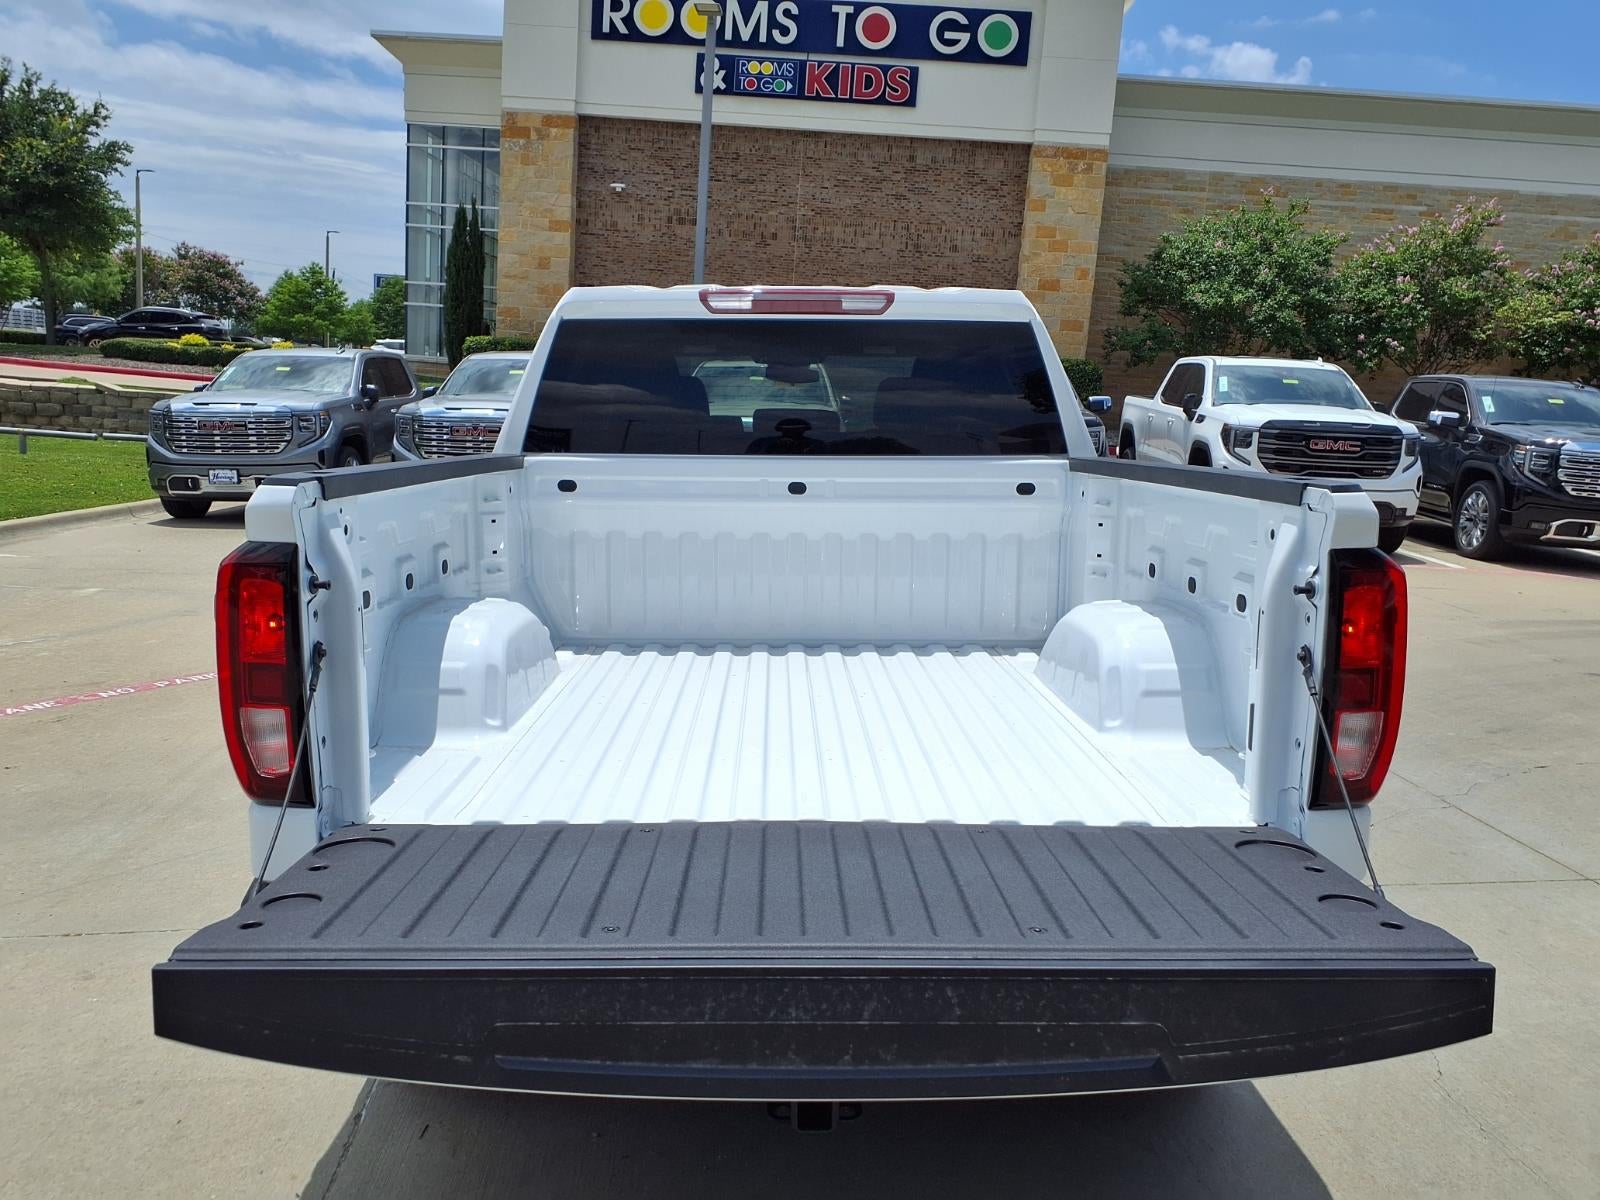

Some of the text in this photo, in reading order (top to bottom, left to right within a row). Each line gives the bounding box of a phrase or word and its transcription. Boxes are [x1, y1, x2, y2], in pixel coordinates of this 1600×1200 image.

[602, 0, 1020, 58] ROOMS TO GO
[738, 60, 795, 77] ROOMS
[739, 76, 786, 93] TO GO
[804, 61, 911, 103] KIDS
[199, 420, 246, 431] GMC
[451, 425, 501, 437] GMC
[1309, 439, 1361, 451] GMC
[0, 700, 64, 717] ANE
[97, 686, 135, 699] NO
